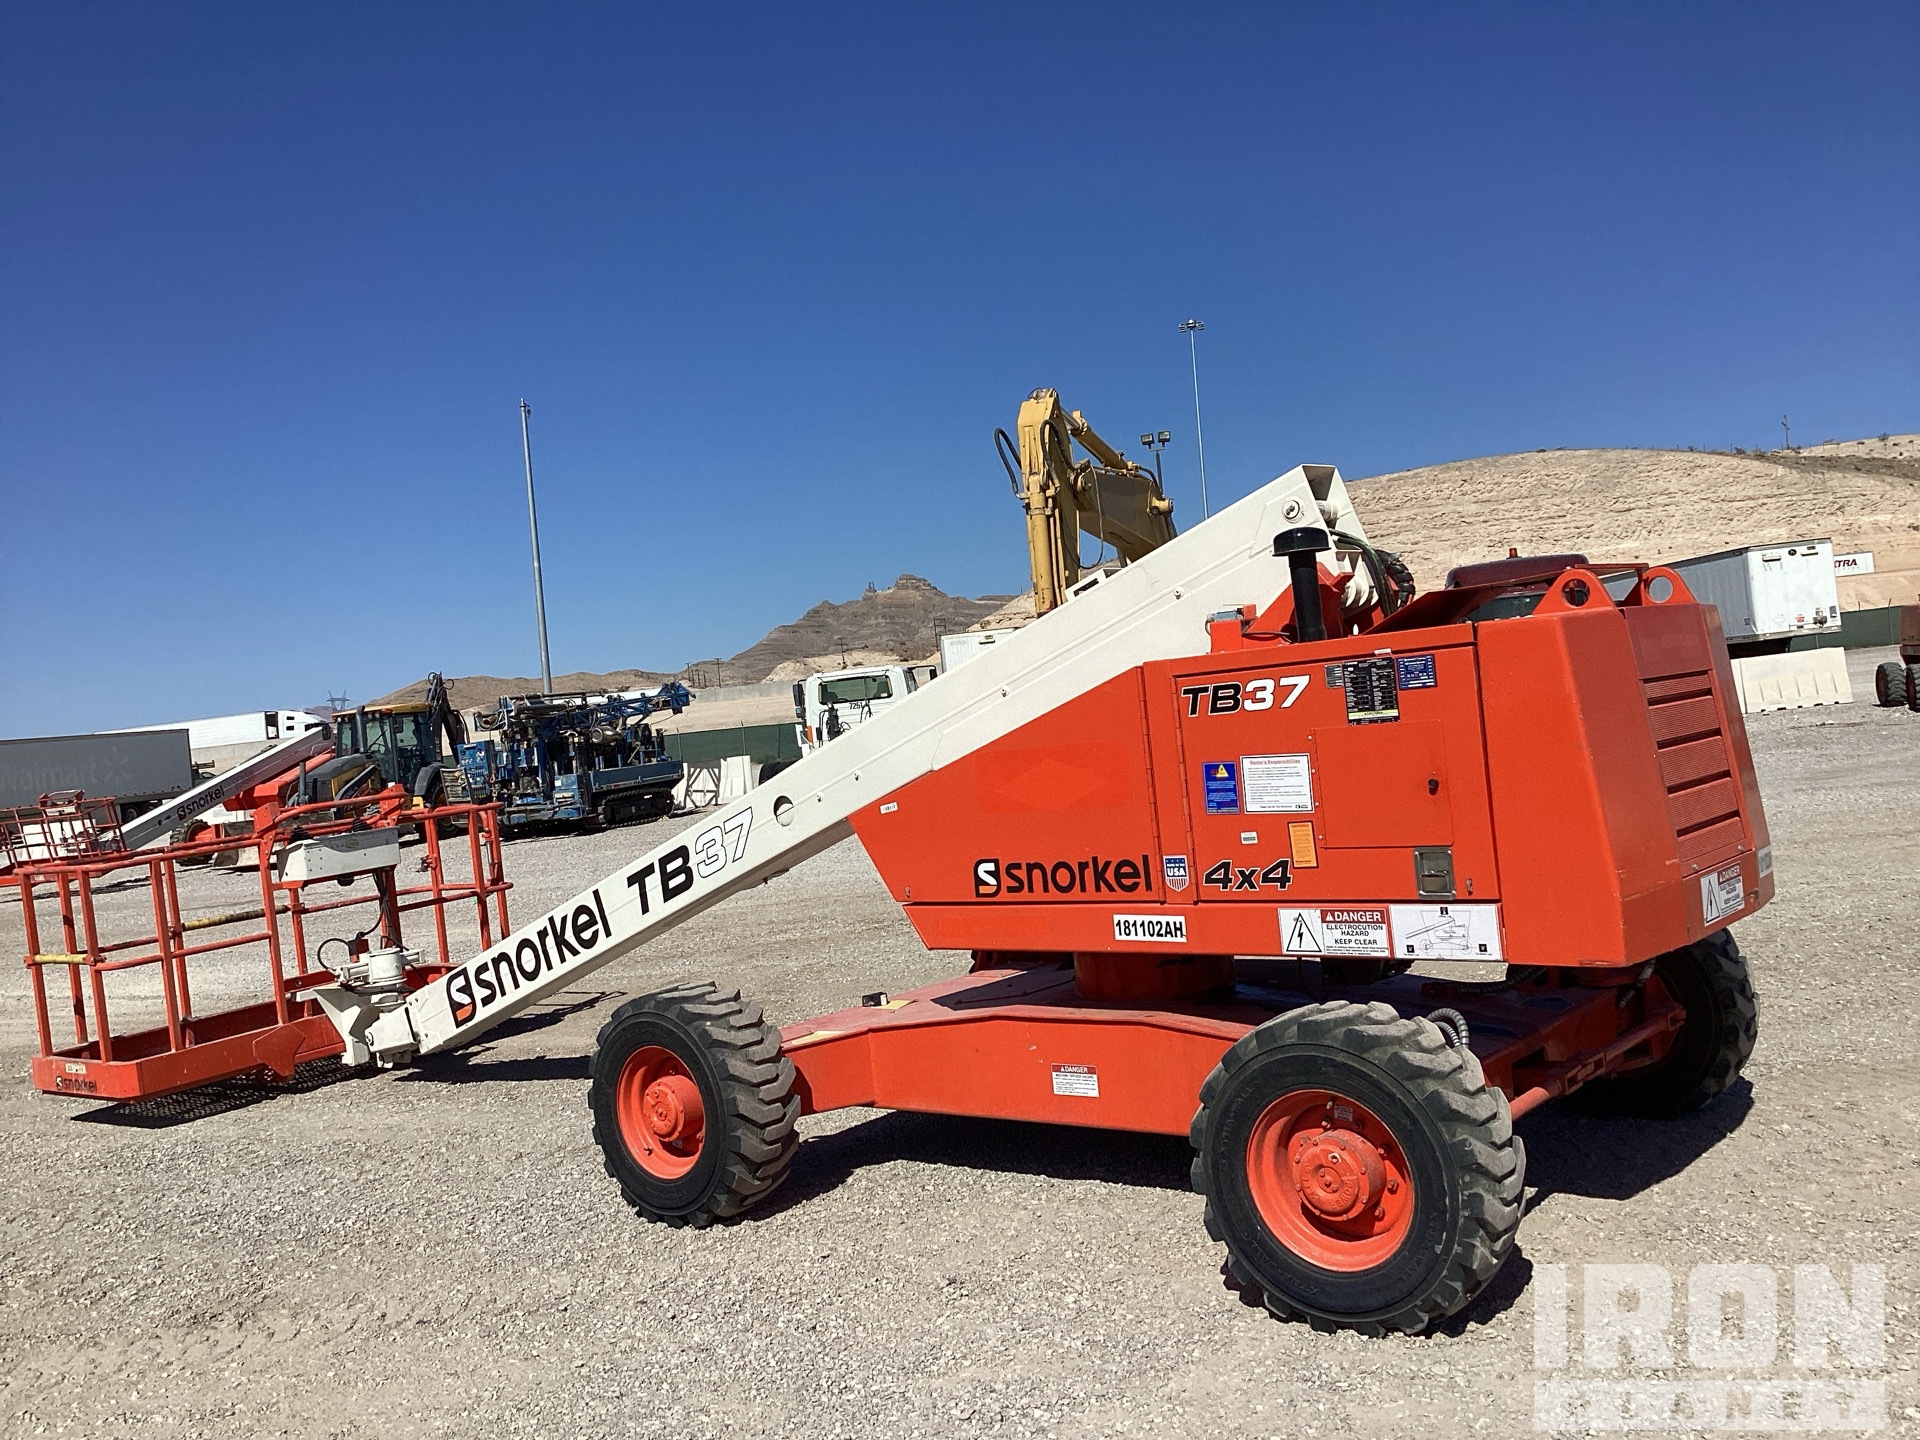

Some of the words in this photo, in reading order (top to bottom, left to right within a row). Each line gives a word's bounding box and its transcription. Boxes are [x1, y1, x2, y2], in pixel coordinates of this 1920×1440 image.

[1181, 675, 1311, 717] TB37
[185, 785, 225, 815] snorkel
[626, 806, 754, 916] TB37
[1006, 854, 1153, 894] snorkel
[1167, 867, 1186, 877] USA
[1203, 858, 1293, 892] 4x4
[1115, 918, 1186, 940] 181102AH
[1334, 911, 1382, 922] DANGER
[474, 889, 613, 1008] snorkel
[63, 1078, 98, 1094] snorkel
